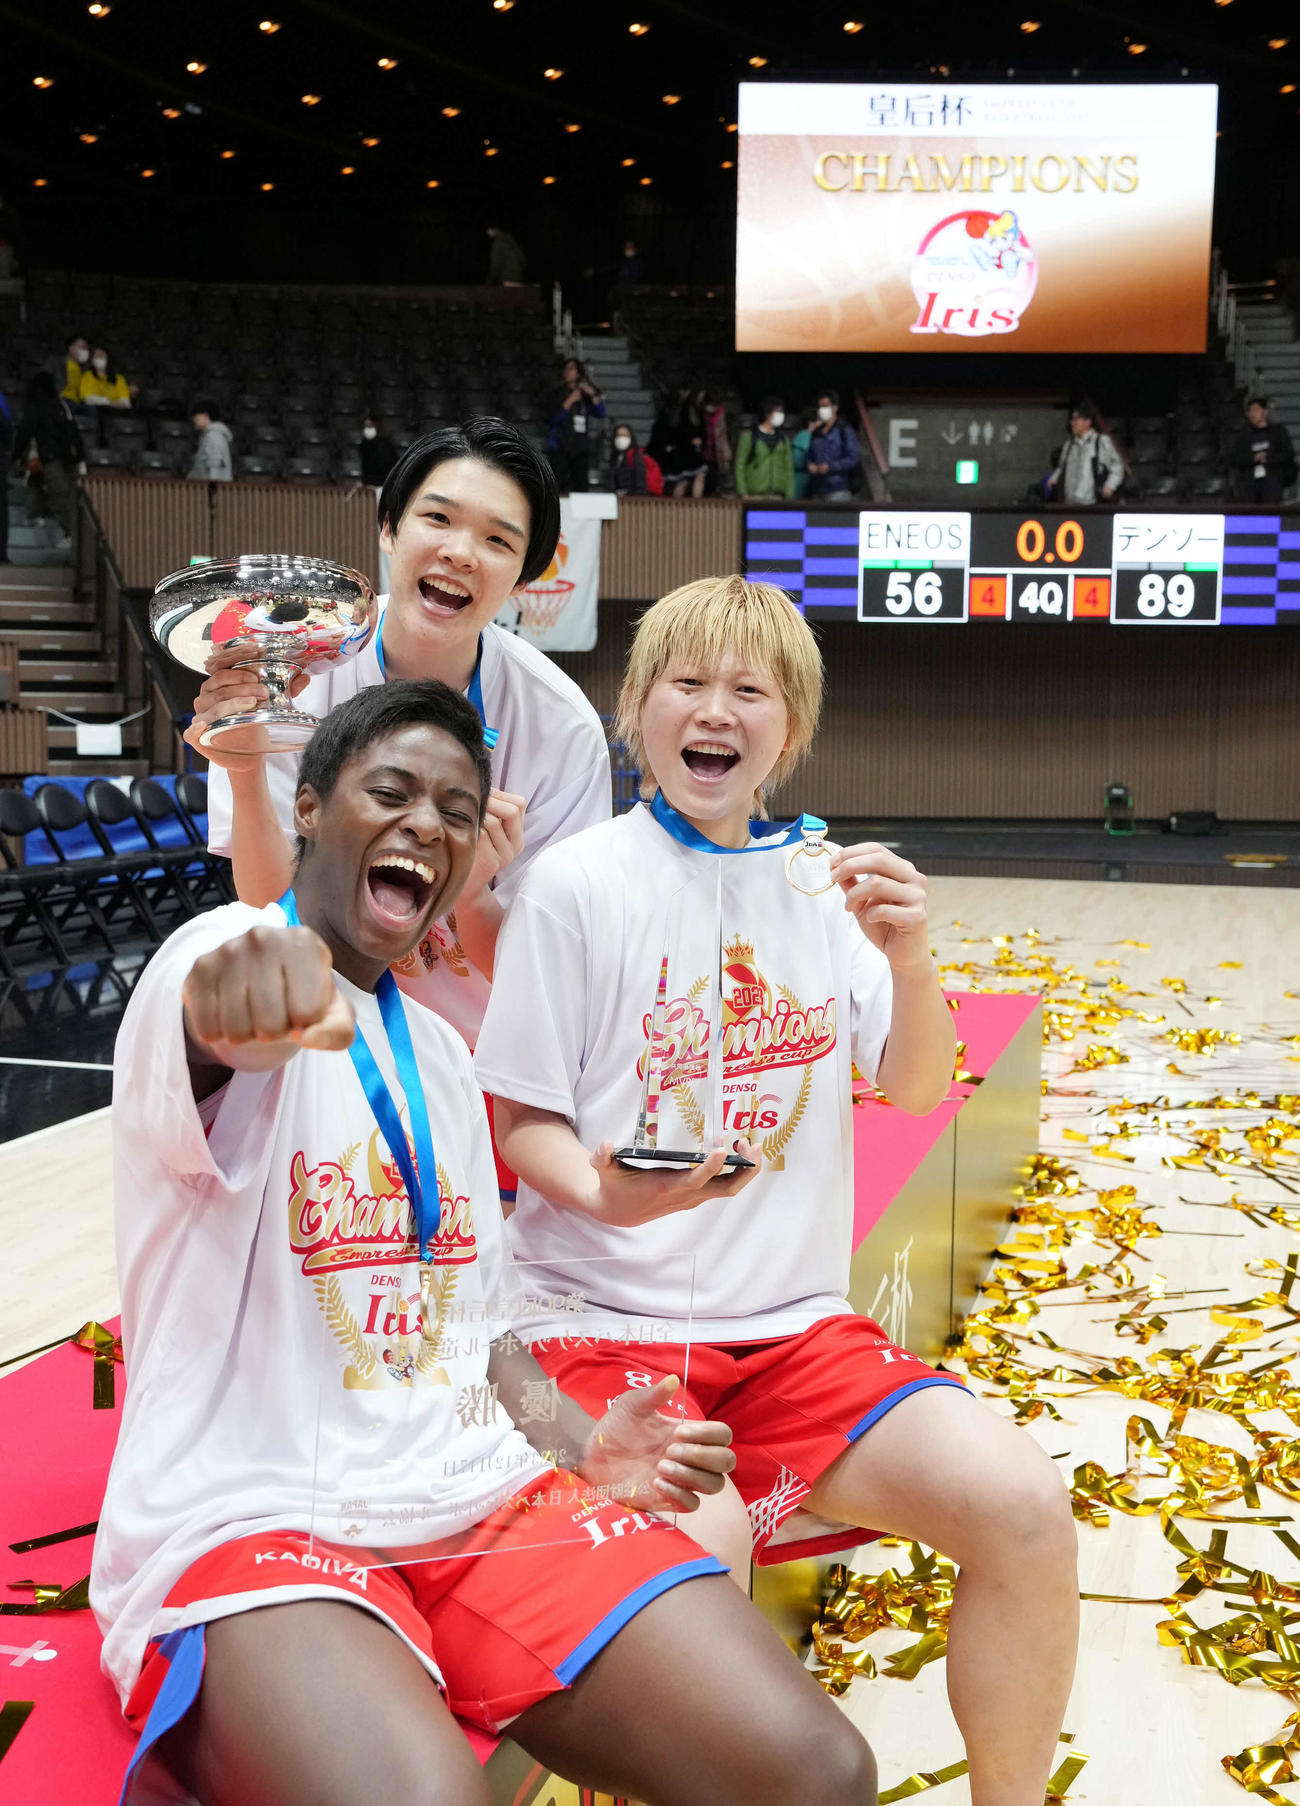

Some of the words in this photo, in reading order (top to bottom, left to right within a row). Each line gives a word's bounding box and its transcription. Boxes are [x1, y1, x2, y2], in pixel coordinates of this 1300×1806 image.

[866, 93, 973, 127] 皇后杯
[812, 151, 1139, 194] CHAMPIONS
[914, 292, 1015, 330] Iris
[888, 419, 918, 467] E
[867, 523, 962, 550] ENEOS
[1016, 519, 1084, 563] 0.0
[885, 571, 943, 616] 56
[981, 584, 996, 608] 4
[1018, 581, 1063, 615] 4Q
[1084, 584, 1098, 609] 4
[1137, 573, 1195, 618] 89
[722, 1083, 758, 1094] DENSO
[722, 1099, 779, 1131] Iris
[570, 1498, 614, 1523] DENSO
